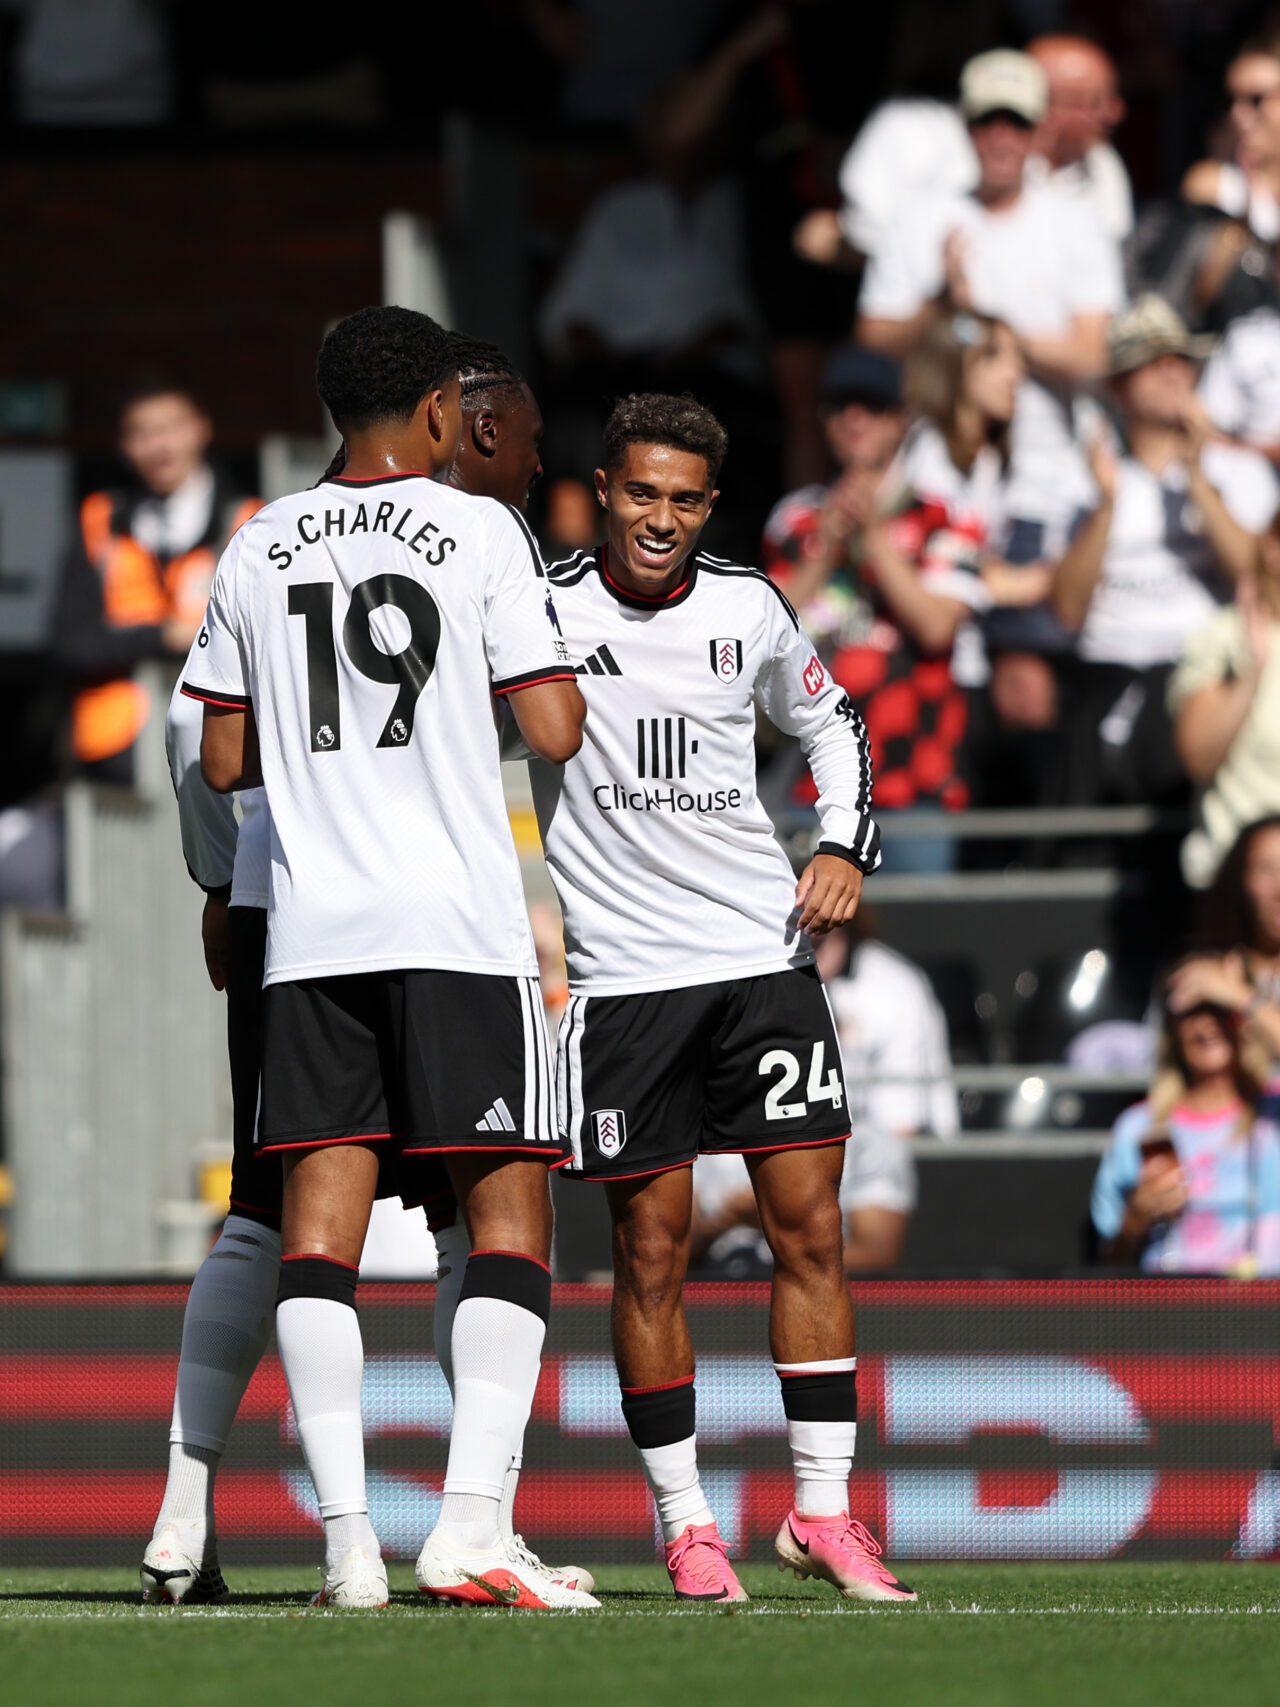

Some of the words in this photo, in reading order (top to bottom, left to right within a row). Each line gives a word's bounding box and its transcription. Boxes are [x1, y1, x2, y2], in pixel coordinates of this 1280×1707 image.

[267, 500, 457, 571] S.CHARLES
[287, 572, 441, 753] 19
[592, 783, 742, 813] ClickHouse
[758, 1040, 843, 1121] 24
